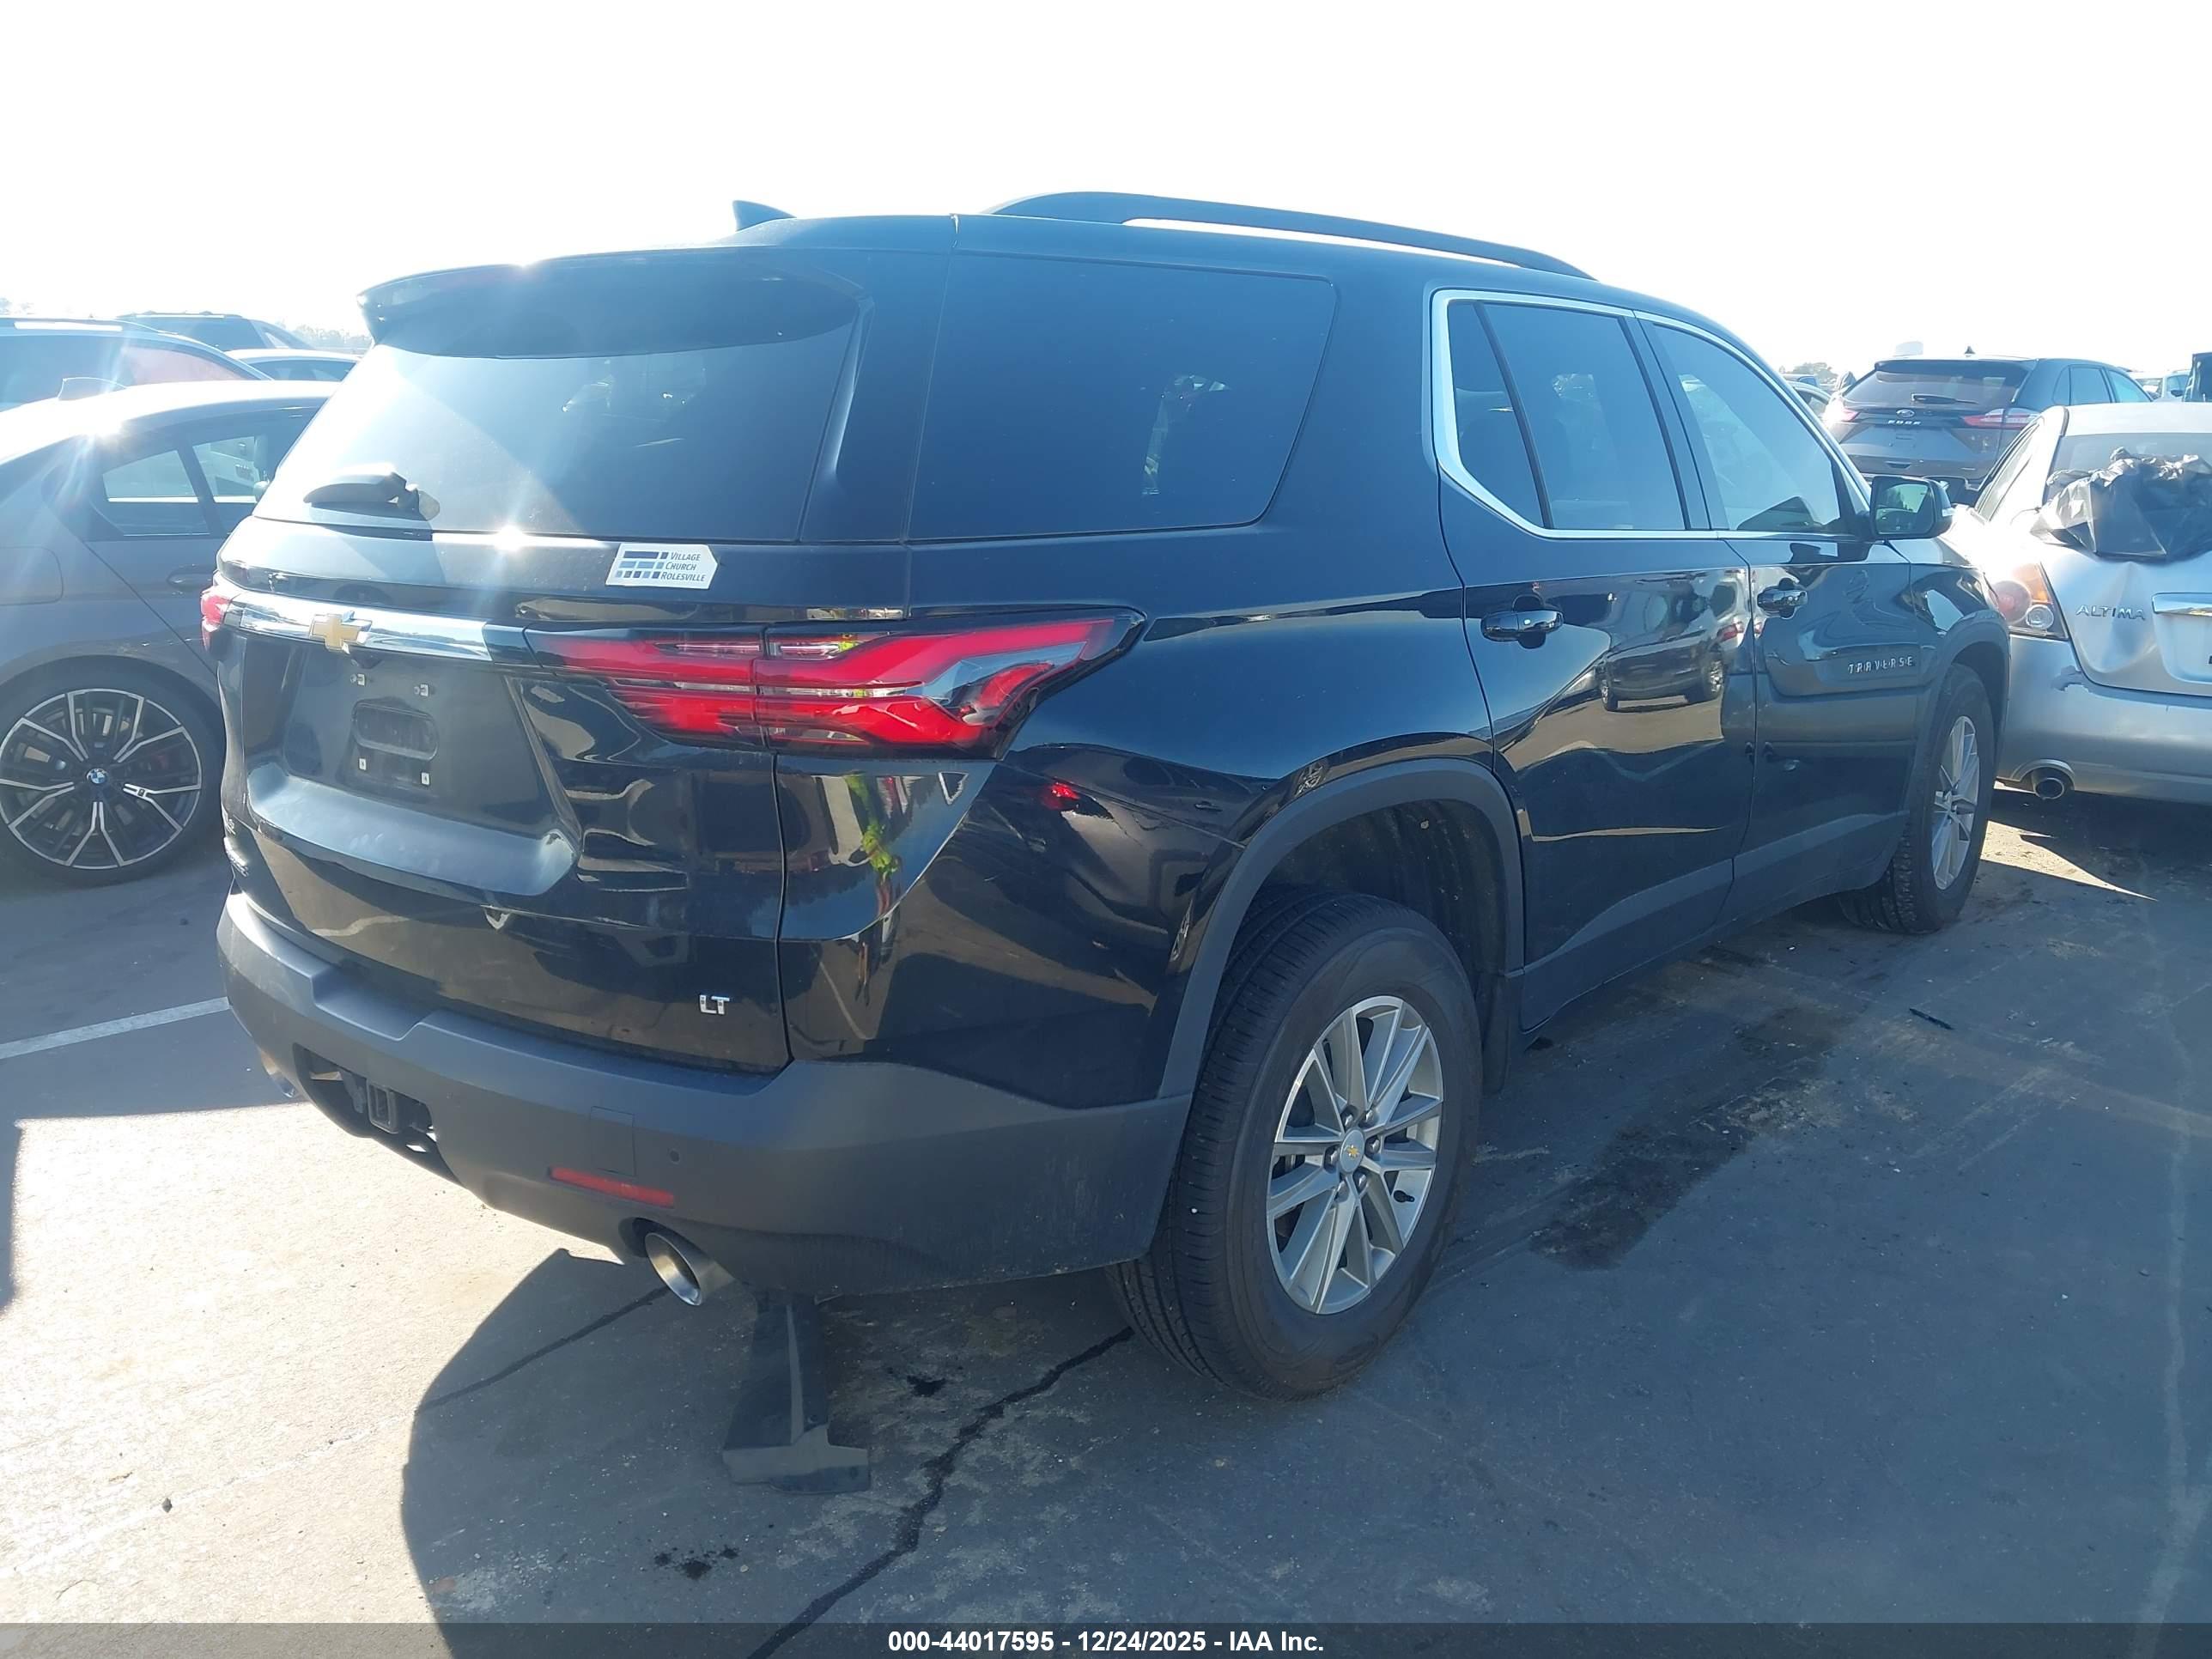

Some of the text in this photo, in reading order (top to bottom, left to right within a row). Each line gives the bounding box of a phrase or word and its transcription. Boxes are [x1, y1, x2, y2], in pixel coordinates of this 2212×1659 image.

[670, 552, 701, 562] VILLAGE
[665, 562, 697, 571] CHURCH
[660, 571, 706, 581] ROLESVILLE
[2075, 604, 2146, 622] ALTIMA
[1847, 655, 1913, 674] TRAVERSE
[699, 994, 730, 1015] LT
